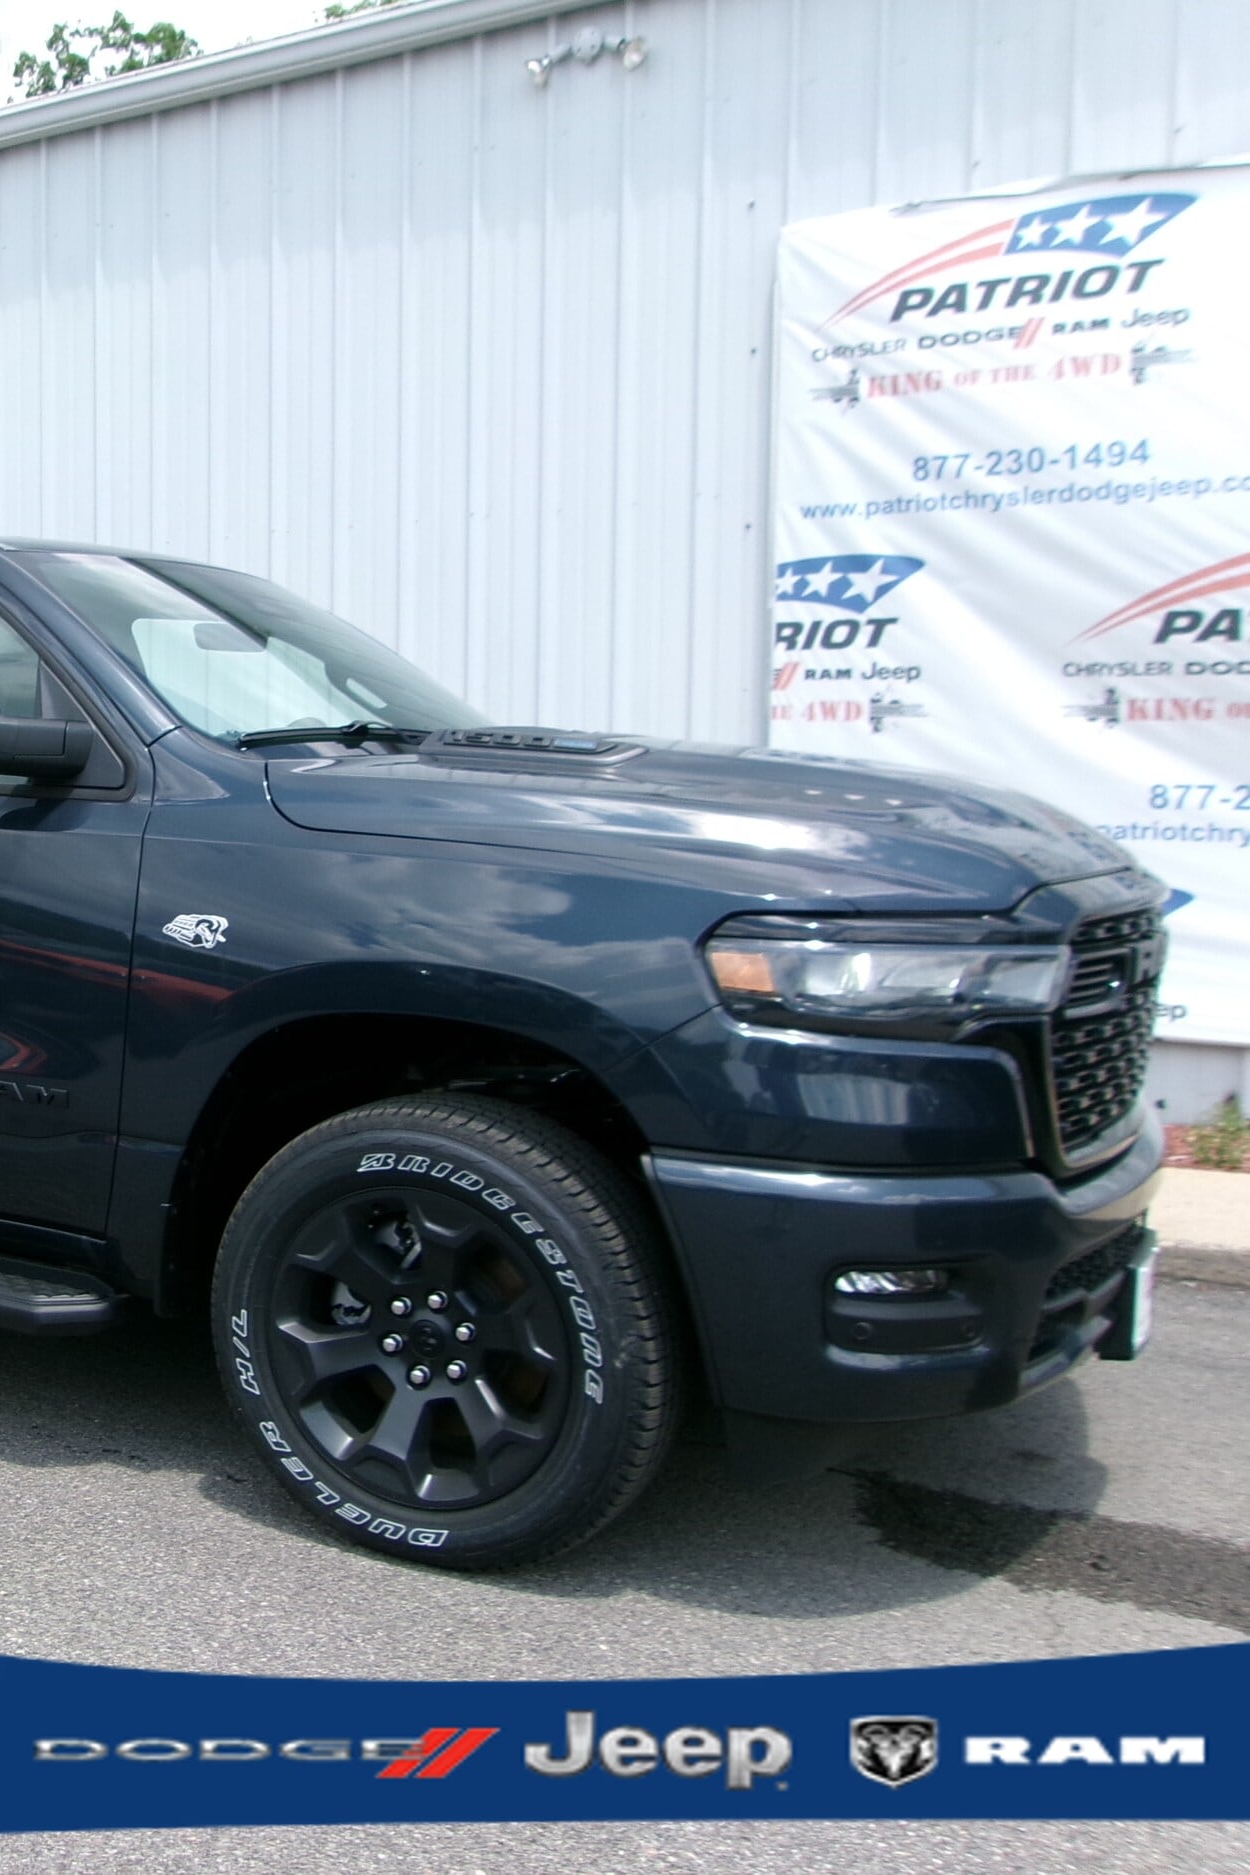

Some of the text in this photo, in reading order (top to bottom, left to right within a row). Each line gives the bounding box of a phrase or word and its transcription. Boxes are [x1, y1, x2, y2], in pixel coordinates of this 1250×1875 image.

[888, 258, 1166, 323] PATRIOT
[812, 308, 1190, 362] CHRYSLER DODGE RAM Jeep
[867, 353, 1123, 398] KING OF THE 4WD
[912, 438, 1152, 482] 877-230-1494
[805, 662, 921, 683] RAM Jeep
[1063, 662, 1171, 677] CHRYSLER
[800, 701, 863, 721] 4WD
[1127, 698, 1216, 721] KING
[357, 1152, 603, 1404] BRIDGESTONE
[232, 1309, 261, 1396] H/L
[259, 1420, 450, 1548] DUELER
